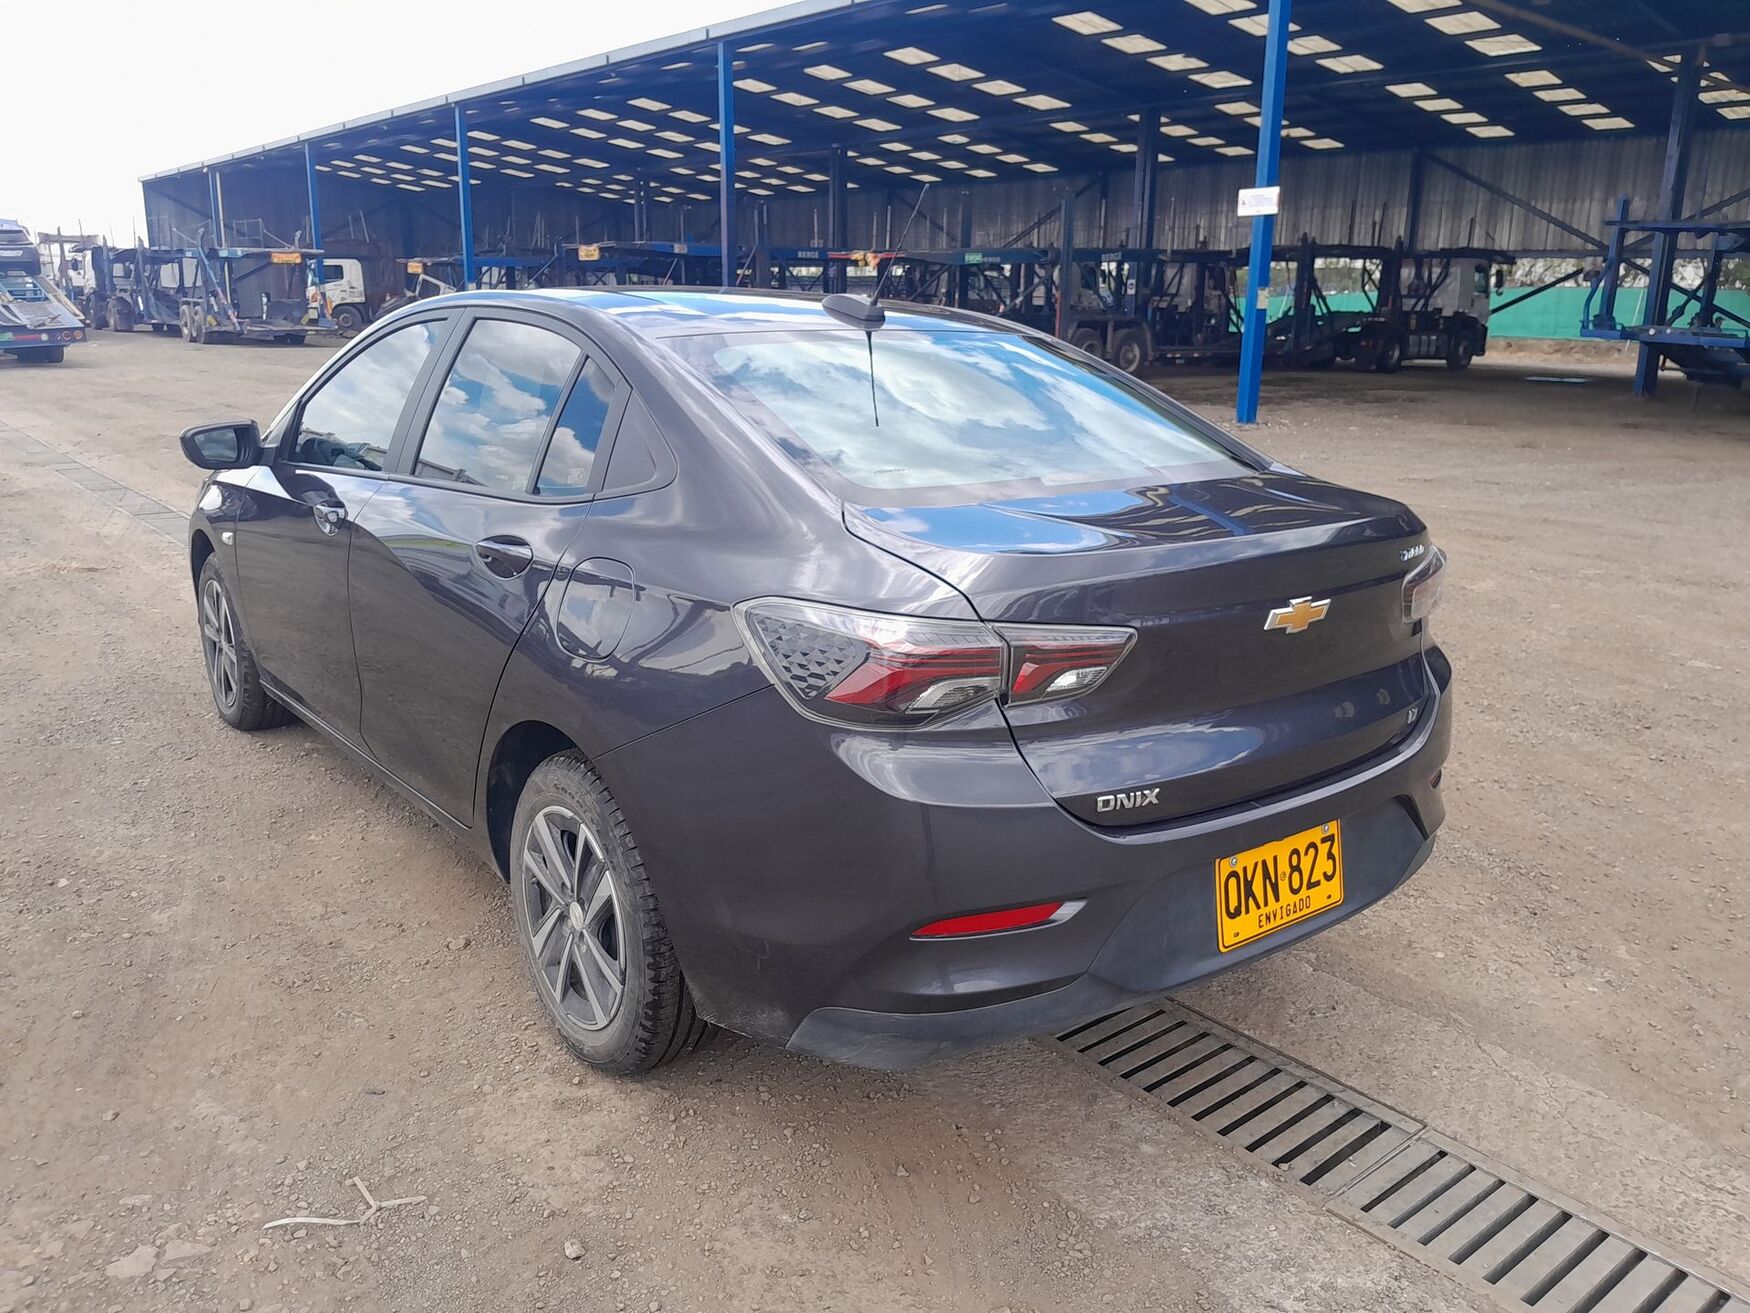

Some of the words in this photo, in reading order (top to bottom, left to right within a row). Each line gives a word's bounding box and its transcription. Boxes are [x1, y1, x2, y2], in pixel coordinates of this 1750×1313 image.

[1096, 788, 1160, 812] ONIX
[1224, 854, 1280, 919] QKN
[1288, 833, 1337, 895] 823
[1258, 896, 1311, 928] ENVIGADO
